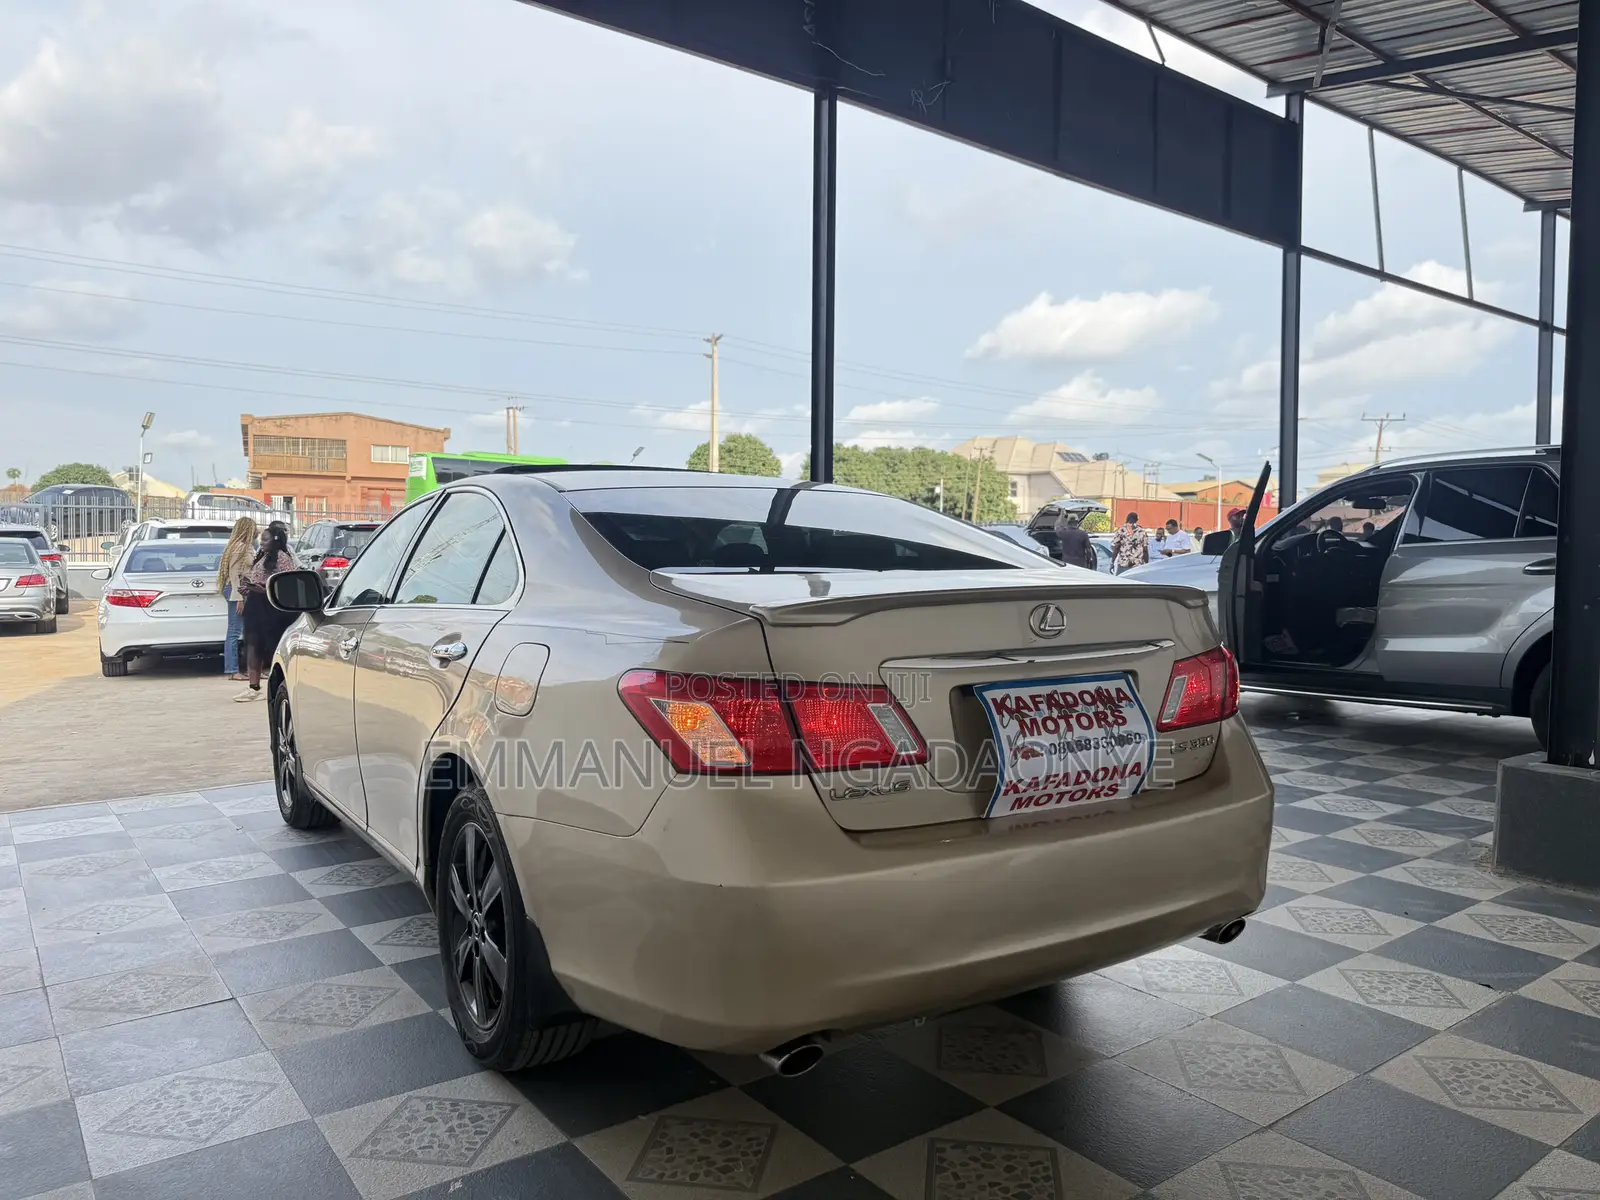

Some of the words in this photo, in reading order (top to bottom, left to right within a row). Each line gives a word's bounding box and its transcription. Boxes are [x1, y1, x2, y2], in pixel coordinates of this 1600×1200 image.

[991, 687, 1135, 716] KAFADONA
[1018, 709, 1128, 738] MOTORS
[829, 779, 911, 801] LEXUS
[1002, 761, 1142, 797] KAFADONA
[1010, 783, 1120, 811] MOTORS
